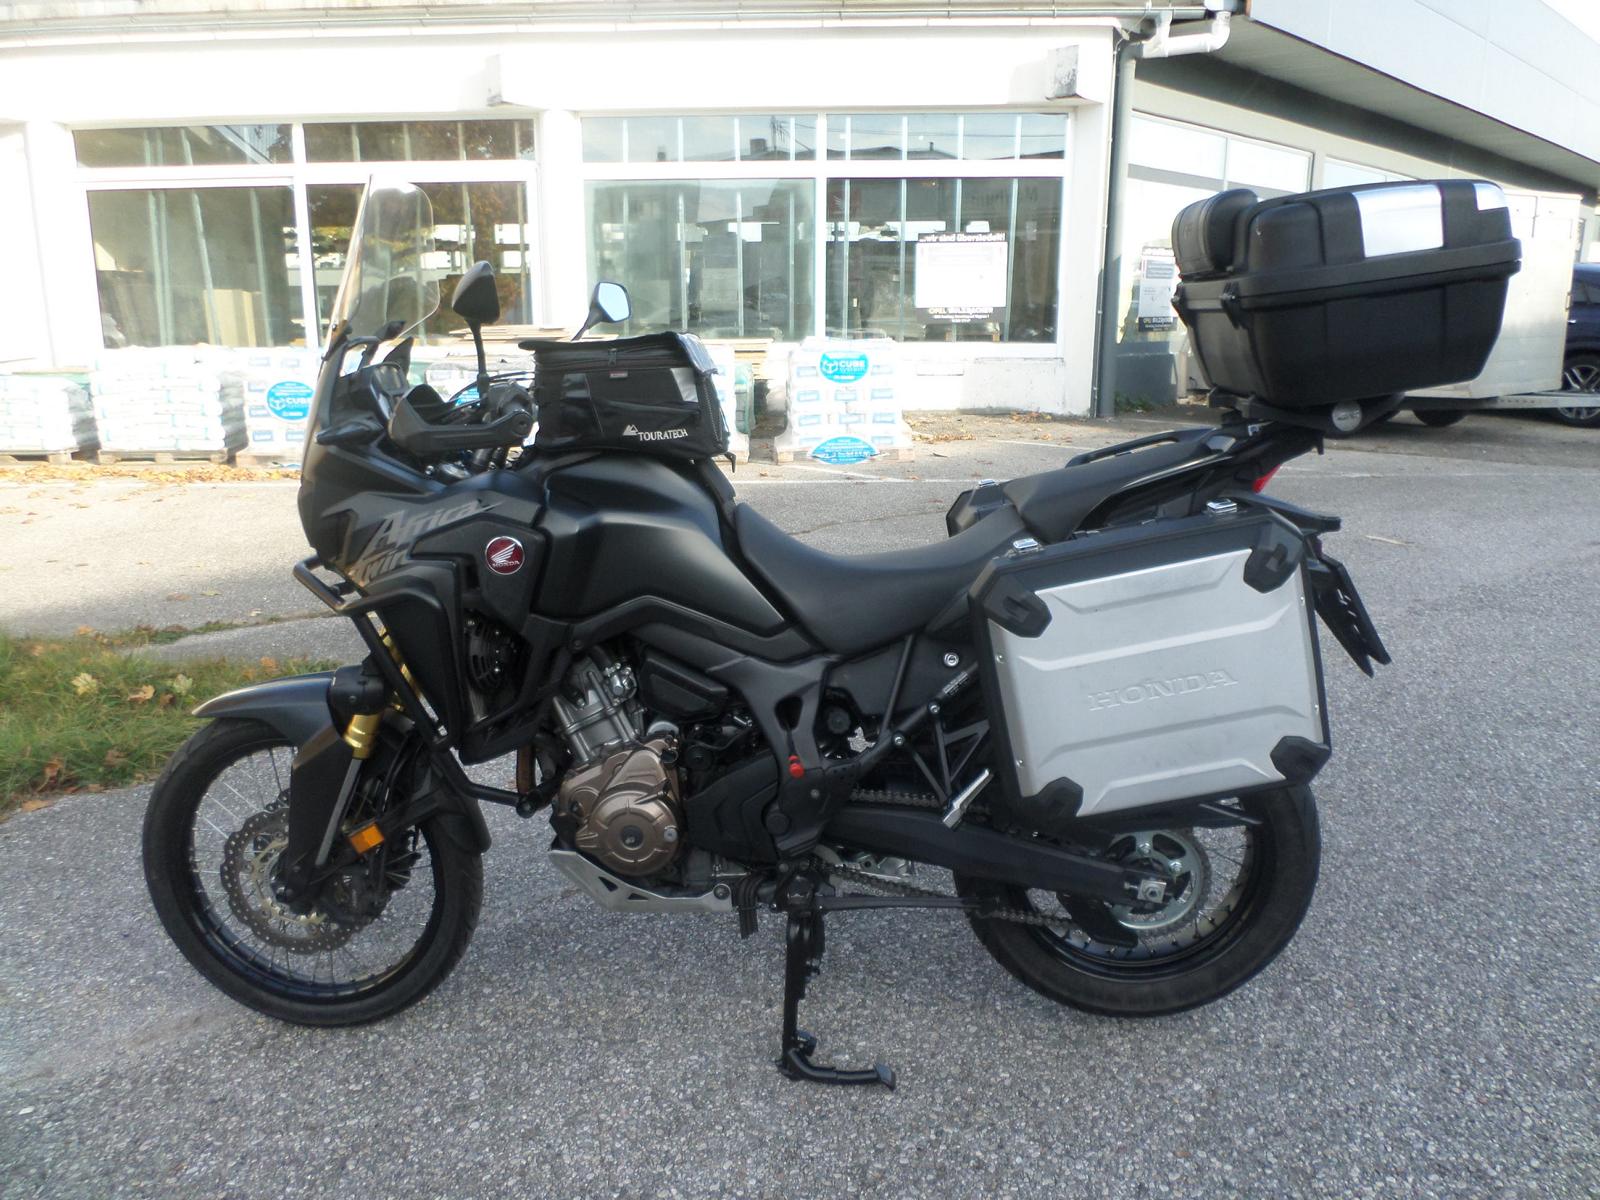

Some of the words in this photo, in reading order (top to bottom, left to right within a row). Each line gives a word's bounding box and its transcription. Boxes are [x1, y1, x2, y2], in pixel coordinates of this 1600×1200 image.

[839, 360, 865, 368] CUBE
[638, 428, 689, 441] TOURATECH
[1088, 669, 1239, 711] HONDA
